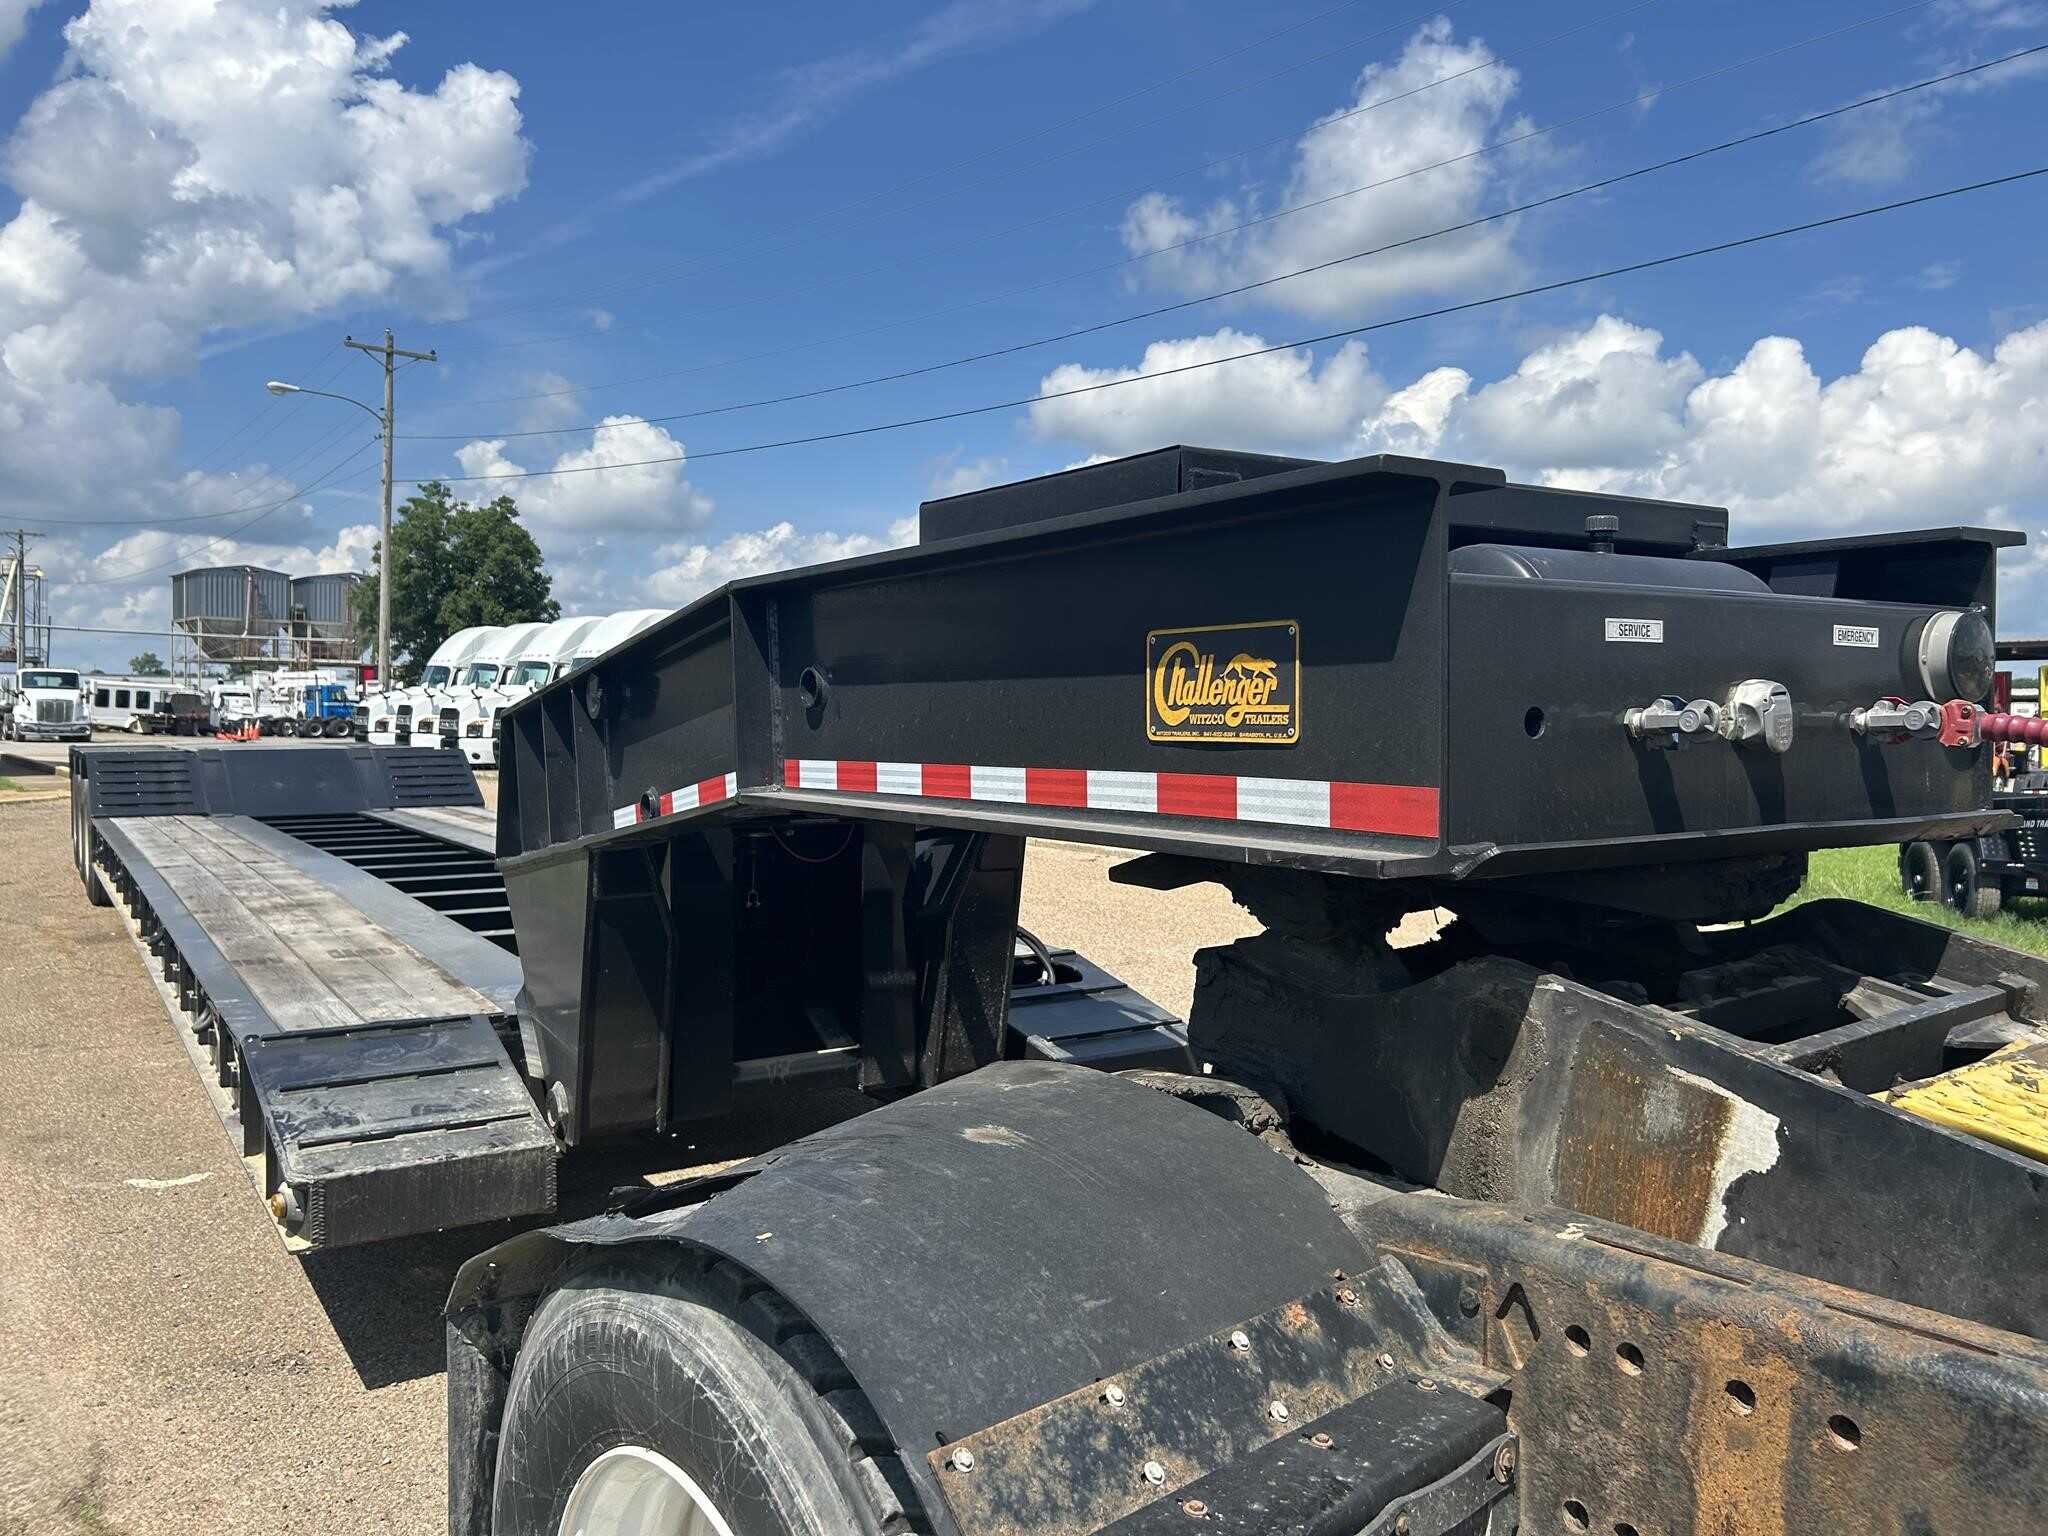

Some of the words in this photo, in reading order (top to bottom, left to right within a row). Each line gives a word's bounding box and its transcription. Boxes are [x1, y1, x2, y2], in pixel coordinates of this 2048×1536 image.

[1618, 623, 1651, 638] SERVICE
[1837, 629, 1874, 643] EMERGENCY
[1154, 641, 1289, 727] Challenger
[1189, 713, 1225, 725] WITZCO
[1245, 714, 1289, 725] TRAILERS
